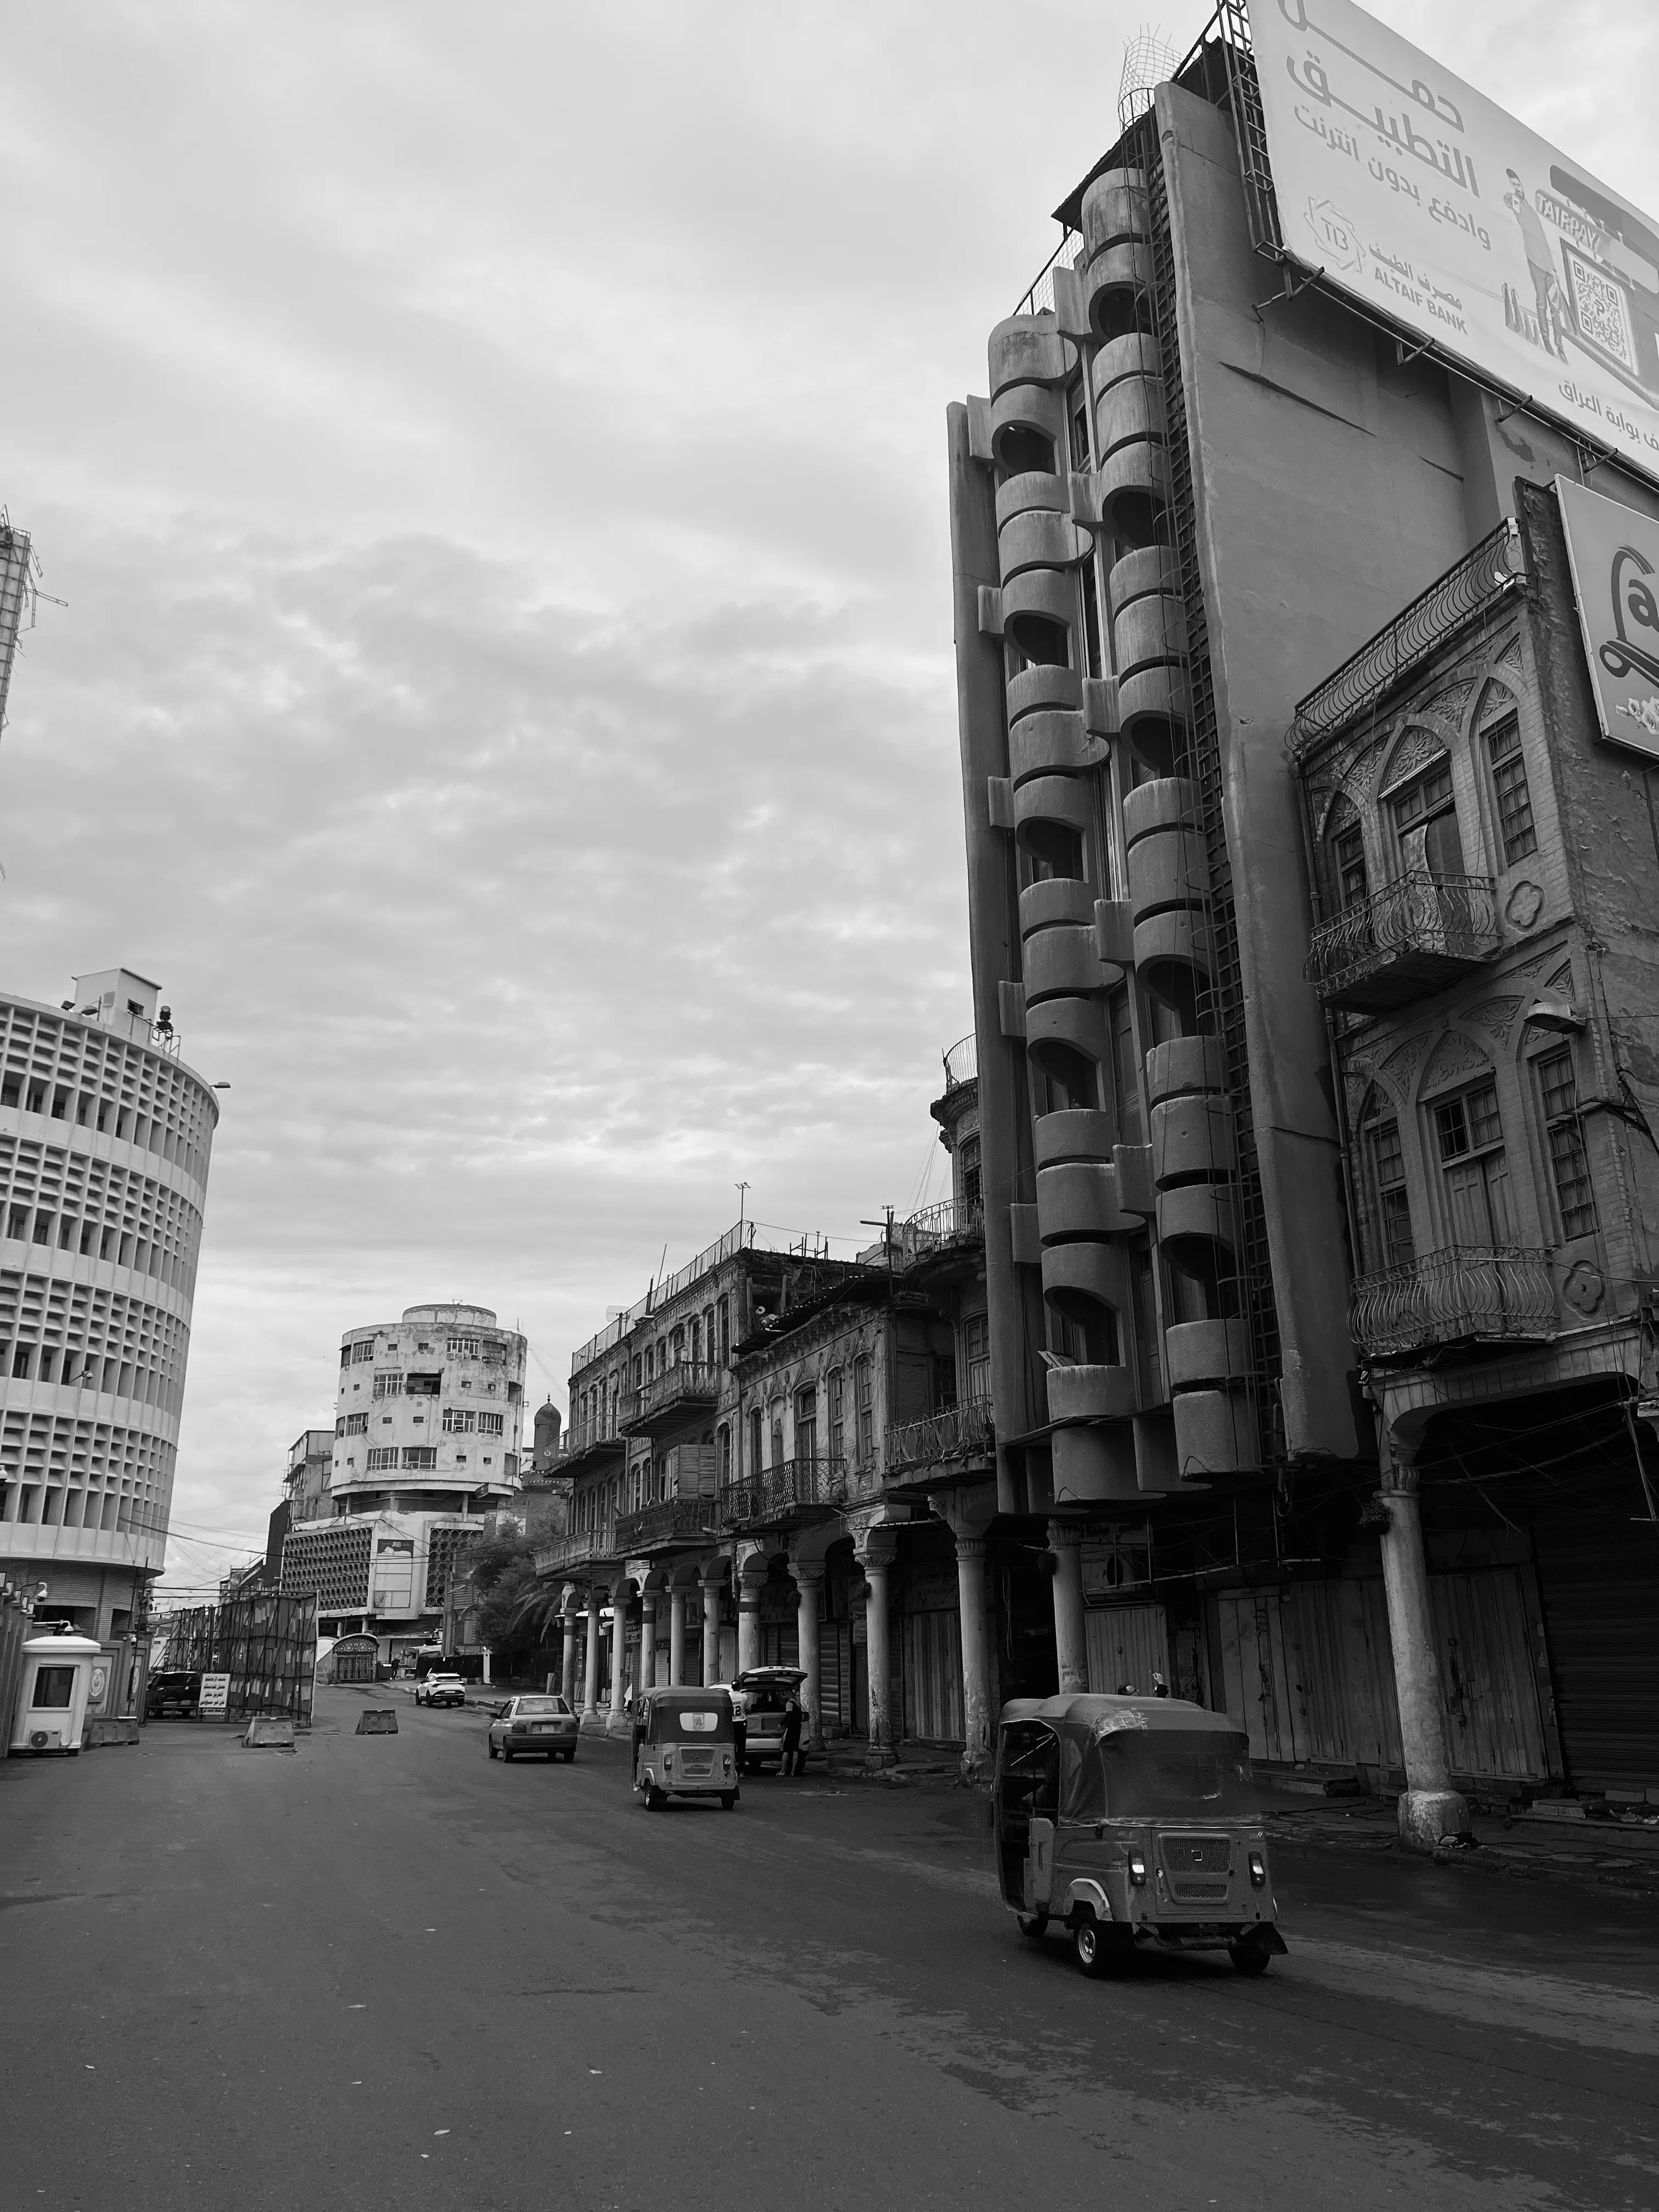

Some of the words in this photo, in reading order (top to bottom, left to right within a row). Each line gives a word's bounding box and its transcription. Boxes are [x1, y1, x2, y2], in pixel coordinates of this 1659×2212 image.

[1286, 50, 1480, 199] التطبيق
[1294, 104, 1360, 162] انترنت
[1368, 157, 1421, 207] بدون
[1428, 198, 1491, 251] وادفع
[1369, 242, 1414, 281] الطيف
[1374, 266, 1423, 307] ALTAIF
[1426, 298, 1469, 336] BANK
[1418, 273, 1463, 312] مصرف
[1558, 379, 1602, 416] العراق
[1606, 405, 1641, 444] بوابة
